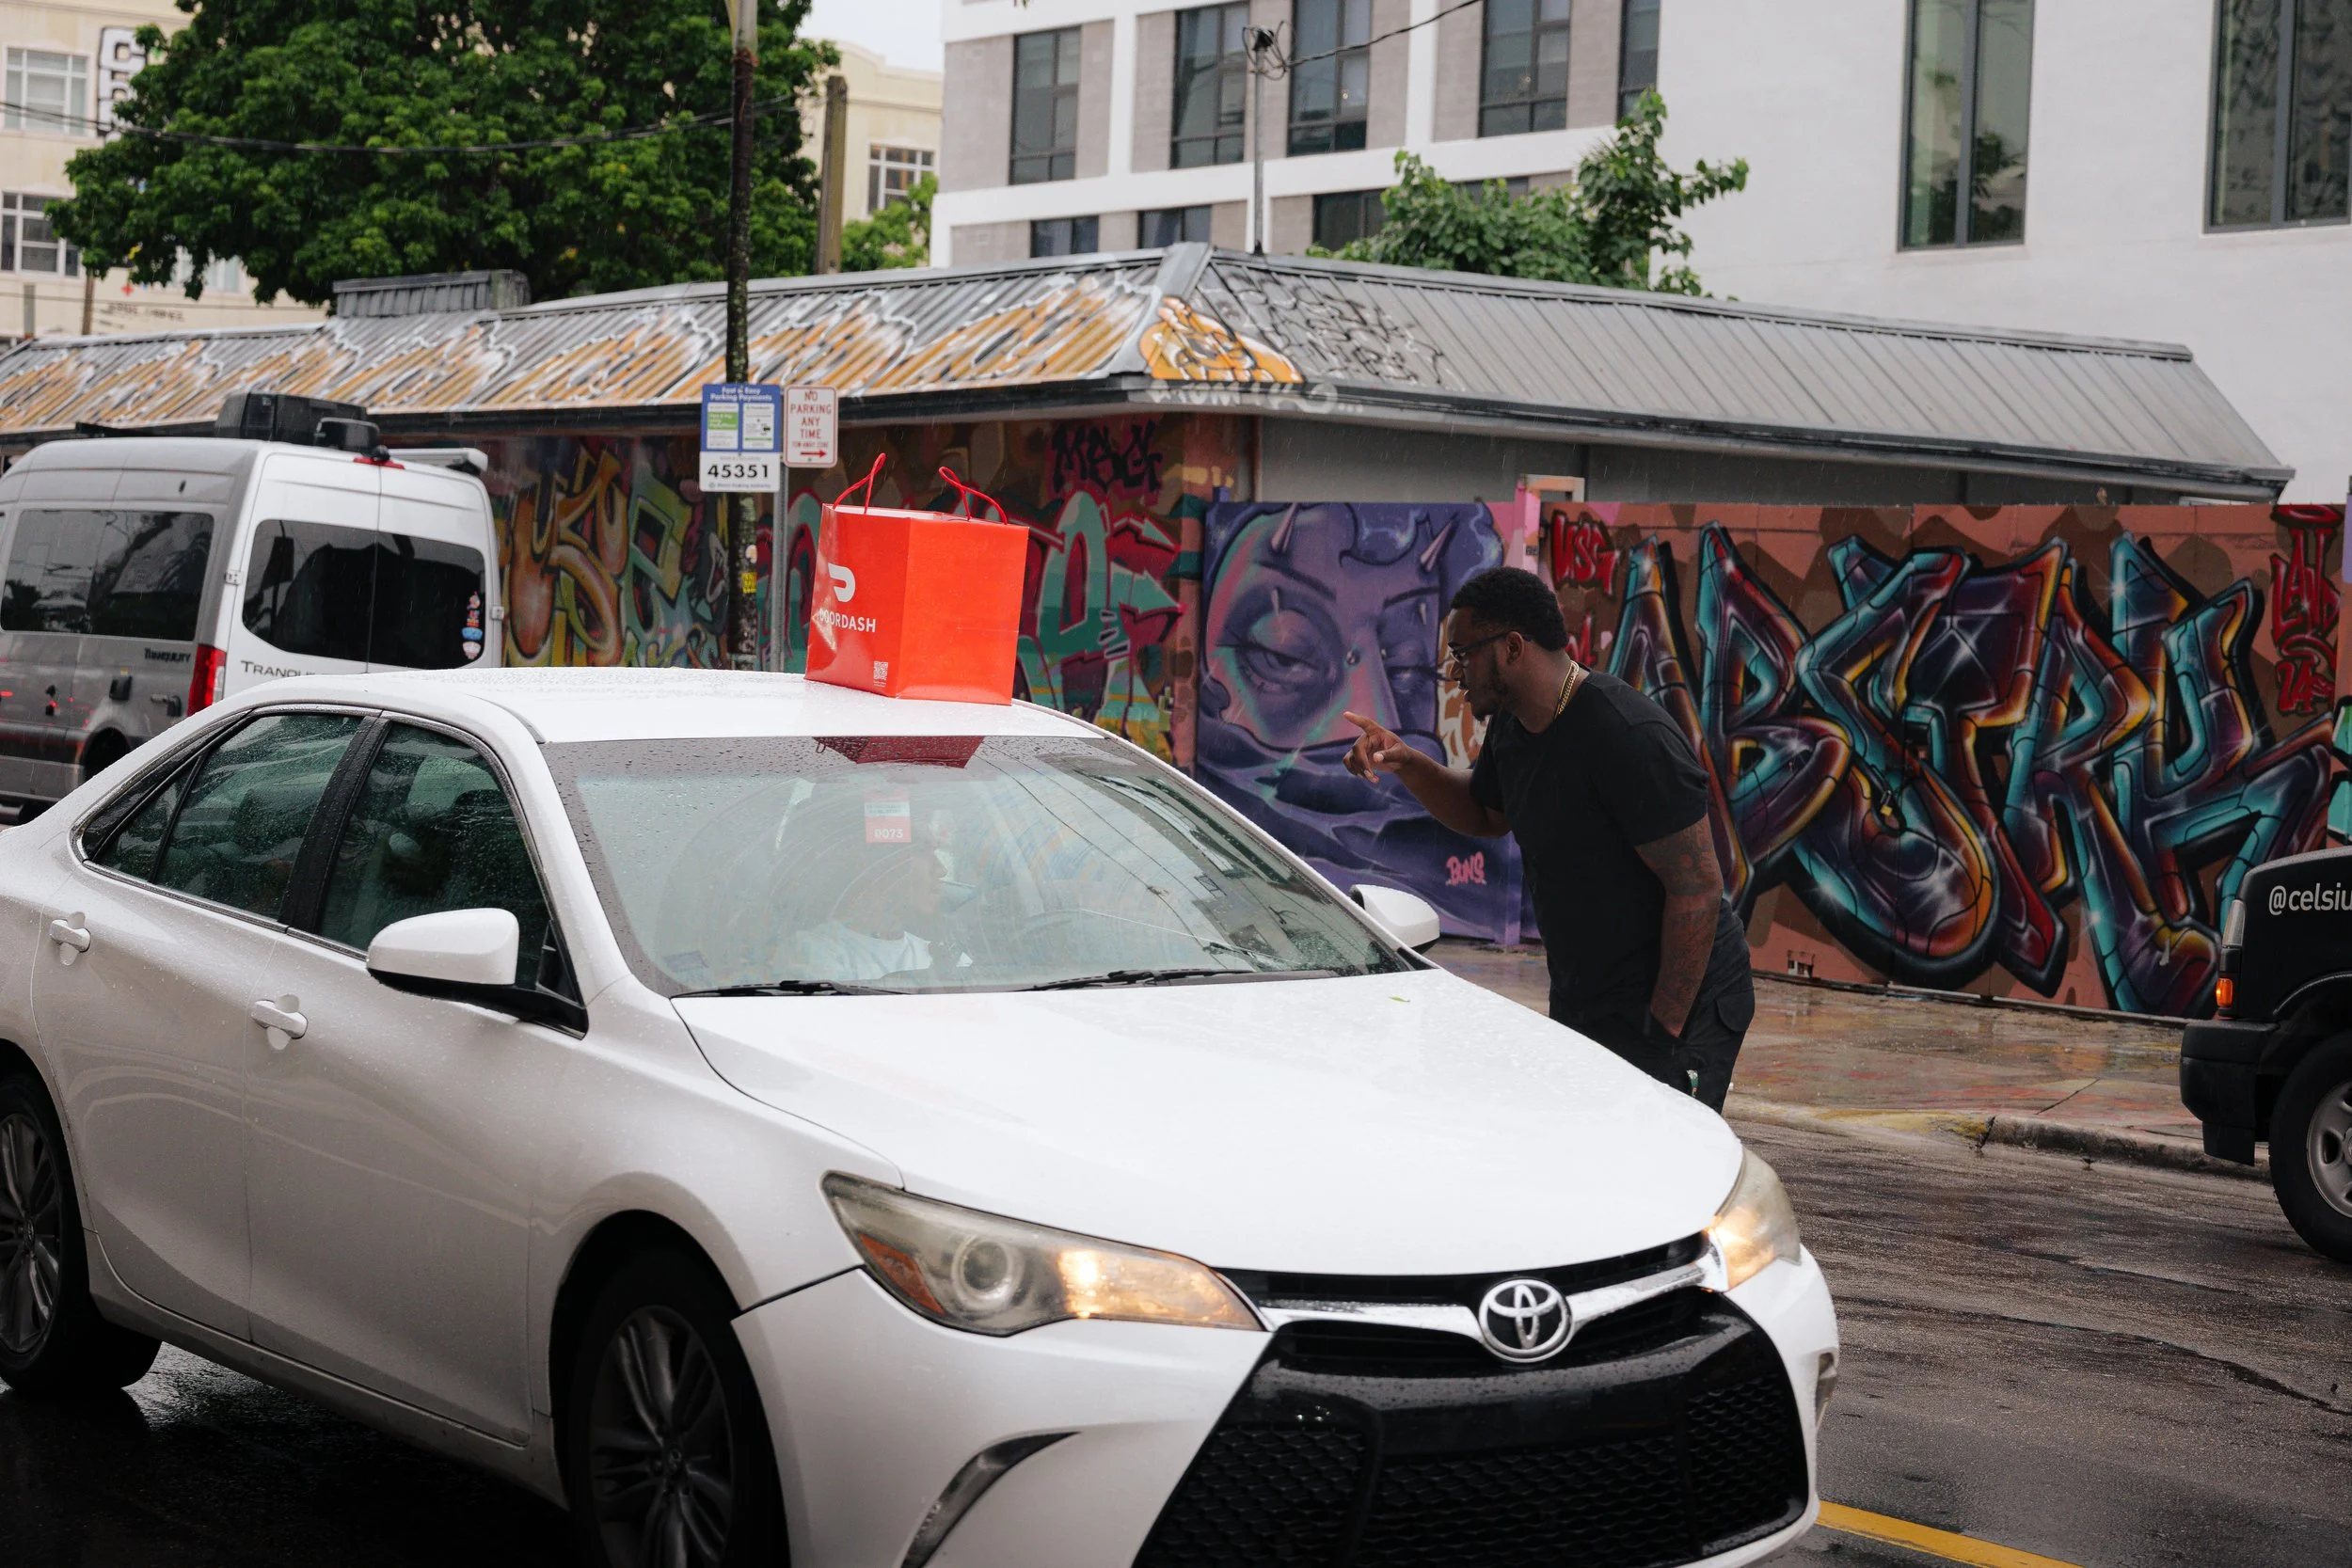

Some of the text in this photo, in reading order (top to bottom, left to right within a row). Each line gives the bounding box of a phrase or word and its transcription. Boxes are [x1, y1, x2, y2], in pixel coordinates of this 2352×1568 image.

[722, 387, 736, 395] Fast
[746, 387, 761, 397] Easy
[804, 390, 818, 401] NO
[710, 394, 772, 404] Parking Payments
[789, 404, 832, 415] PARKING
[802, 417, 820, 427] ANY
[801, 429, 821, 439] TIME
[707, 464, 769, 479] 45351
[818, 607, 876, 633] DOORDASH
